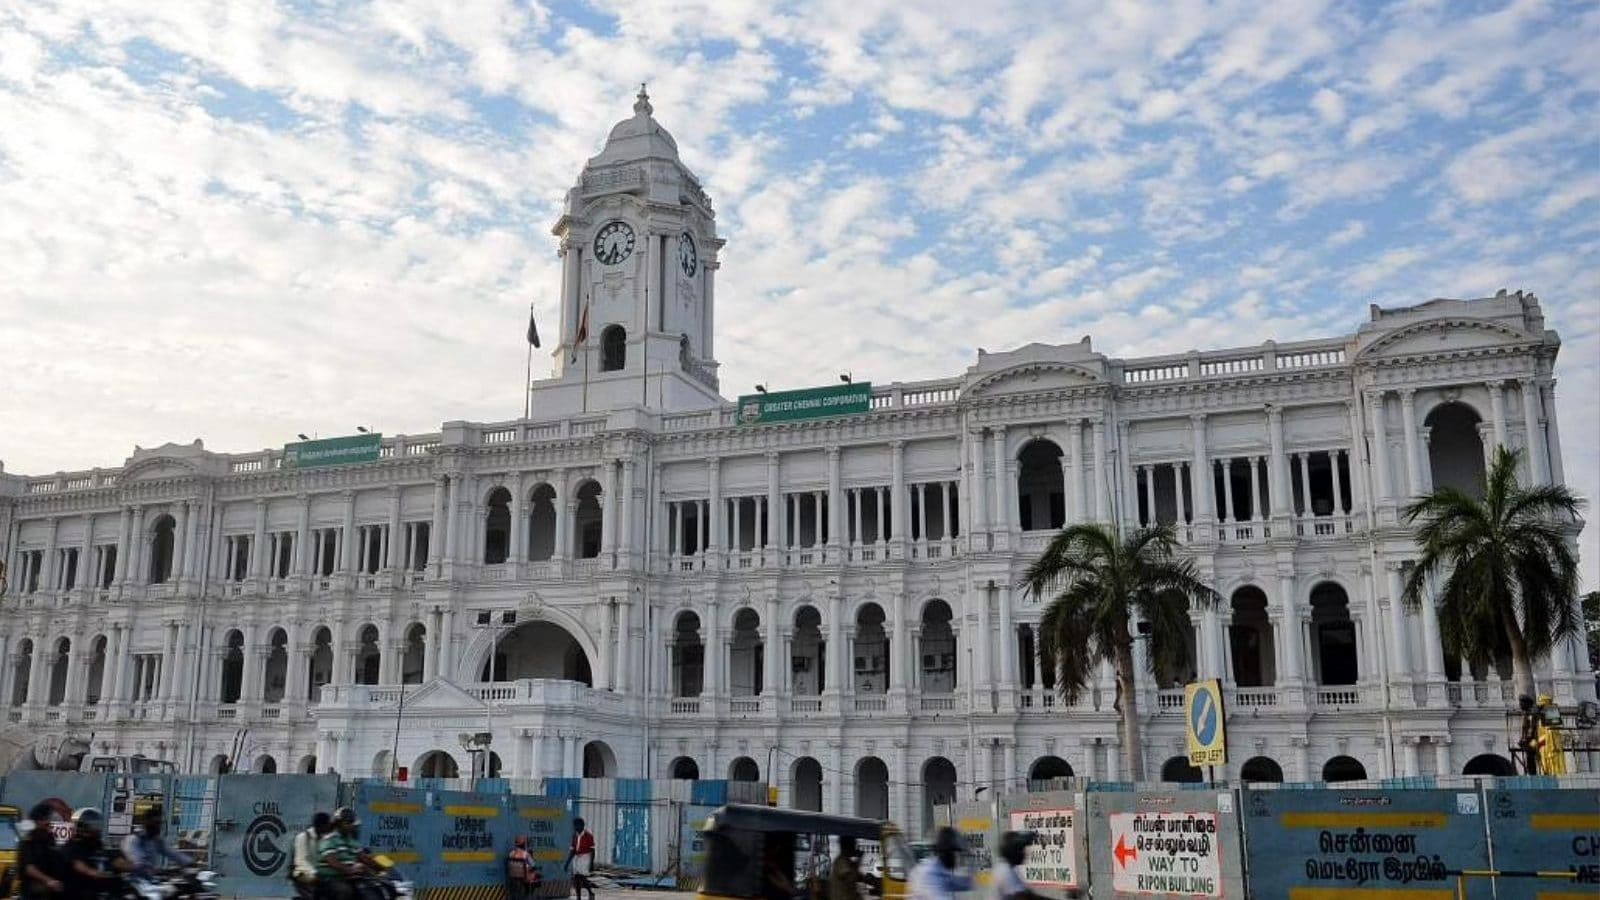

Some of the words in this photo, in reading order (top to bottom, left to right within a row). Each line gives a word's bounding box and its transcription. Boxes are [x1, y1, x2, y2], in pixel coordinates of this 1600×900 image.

[763, 401, 793, 413] GREATER
[793, 398, 822, 410] CHENNAI
[822, 394, 868, 407] CORPORATION
[1191, 751, 1206, 763] KEEP
[1208, 749, 1223, 761] LEFT
[1319, 827, 1416, 854] சென்னை
[1030, 850, 1048, 864] WAY
[1148, 857, 1175, 872] WAY
[1180, 857, 1199, 873] TO
[1138, 874, 1167, 891] RIPON
[1169, 875, 1214, 893] BUILDING
